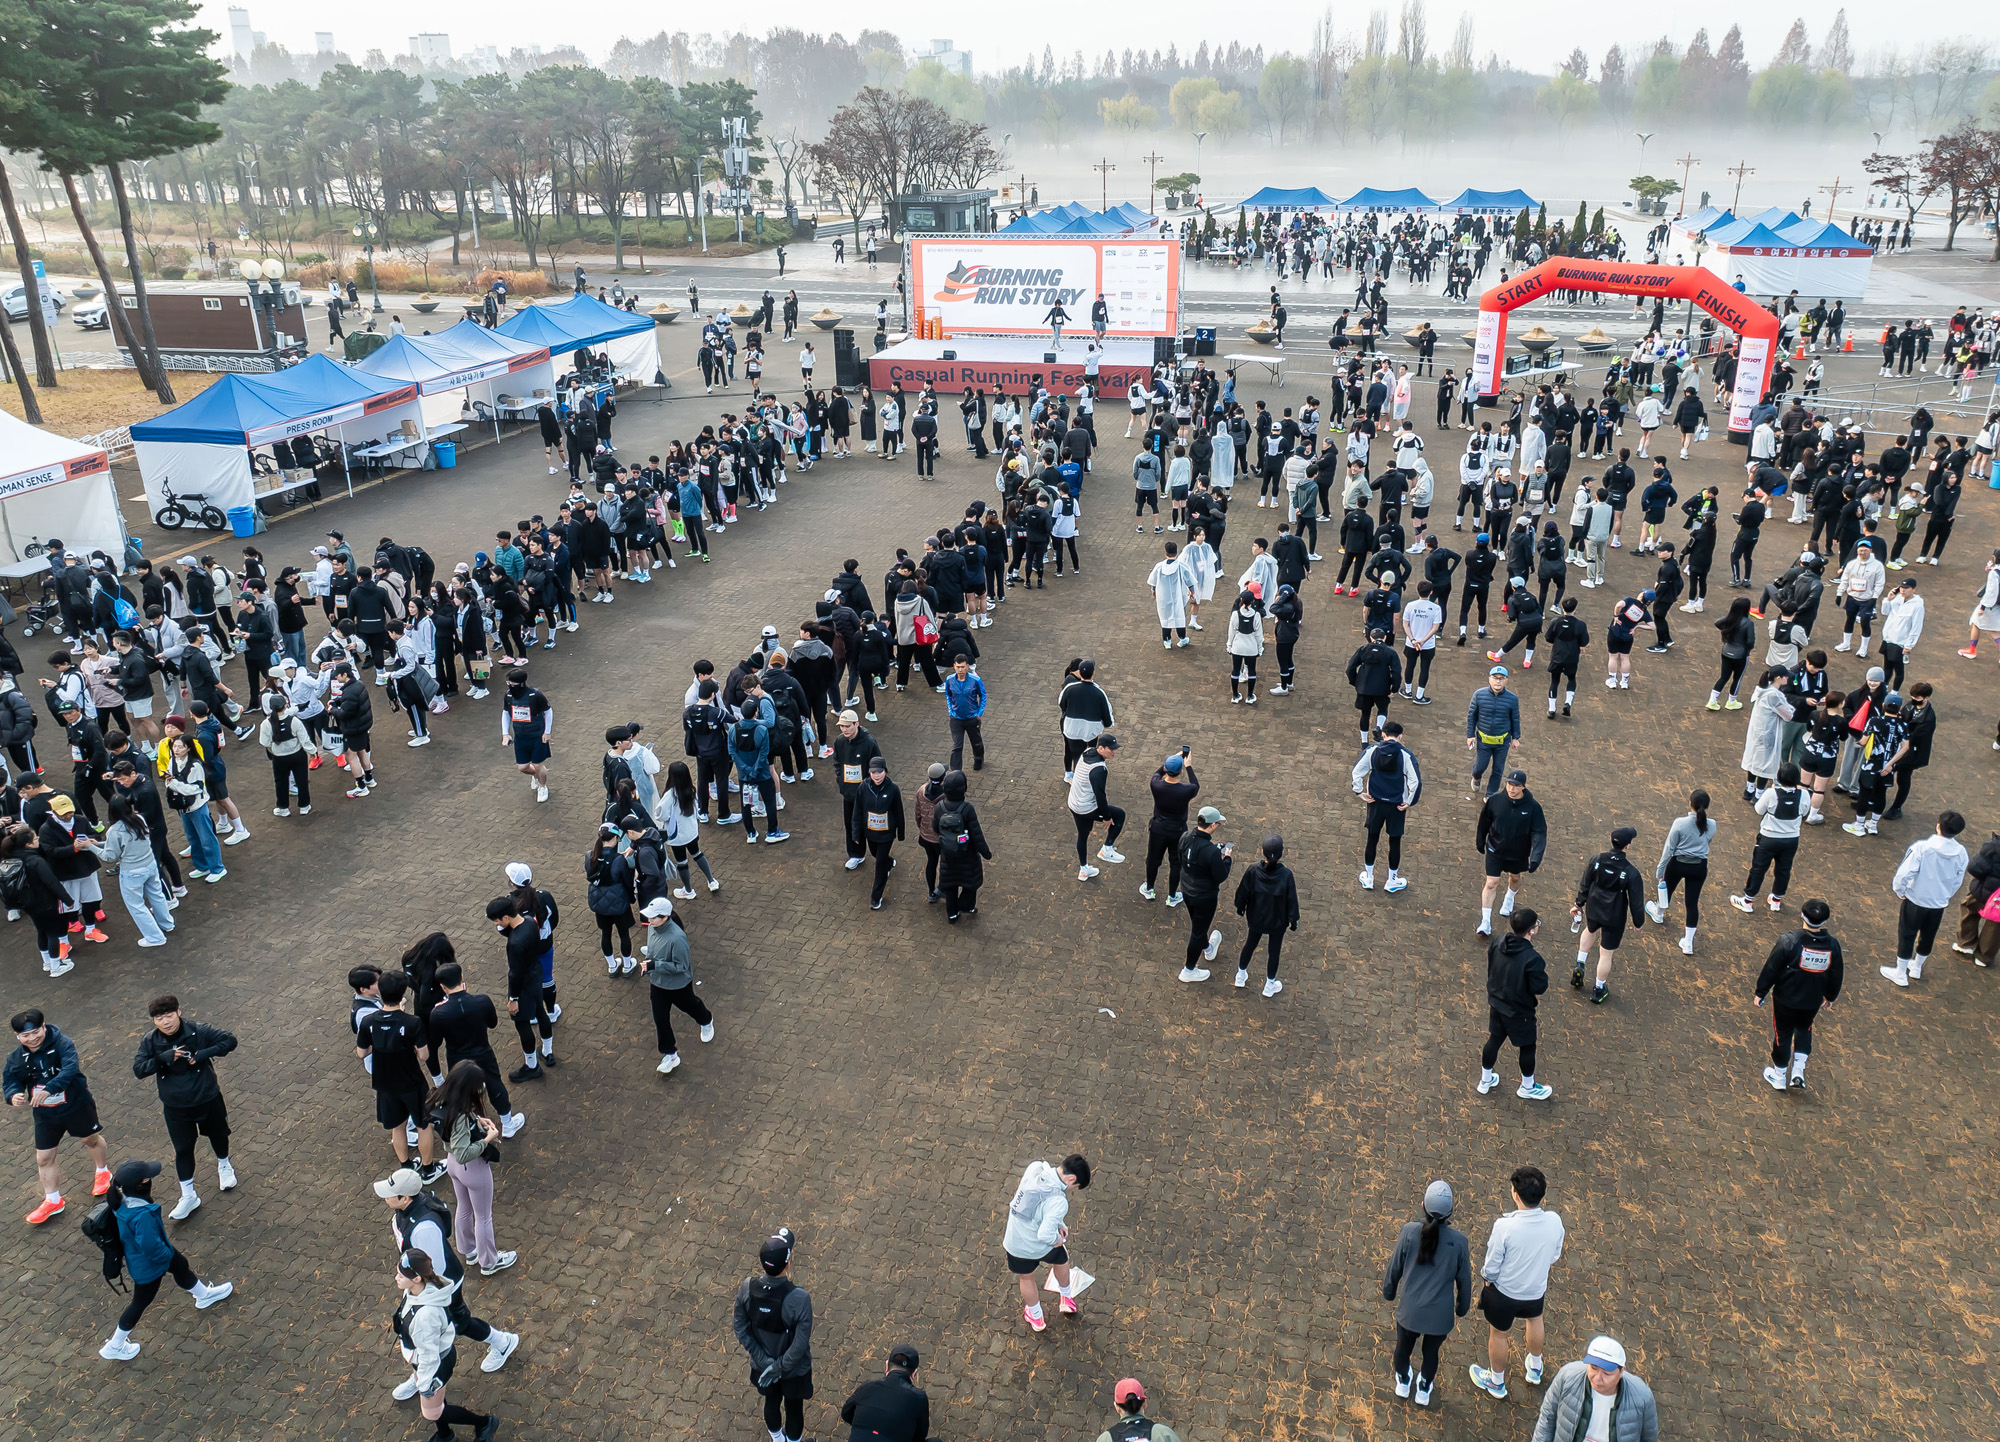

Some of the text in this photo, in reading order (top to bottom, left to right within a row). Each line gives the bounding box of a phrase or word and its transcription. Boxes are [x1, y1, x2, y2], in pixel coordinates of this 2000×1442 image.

[1770, 248, 1833, 258] 여자탈의실
[32, 264, 40, 276] F
[974, 268, 1064, 287] BURNING
[1556, 267, 1675, 288] BURNING RUN STORY
[973, 287, 1018, 305] RUN
[1018, 288, 1086, 307] STORY
[1496, 273, 1544, 306] START
[1696, 288, 1748, 330] FINISH
[1201, 329, 1208, 339] 2
[1741, 356, 1762, 364] SOYJOY
[889, 365, 1129, 389] Casual Runnin Fesval
[285, 414, 334, 435] PRESS ROOM
[26, 471, 54, 488] SENSE
[330, 736, 344, 744] NIK
